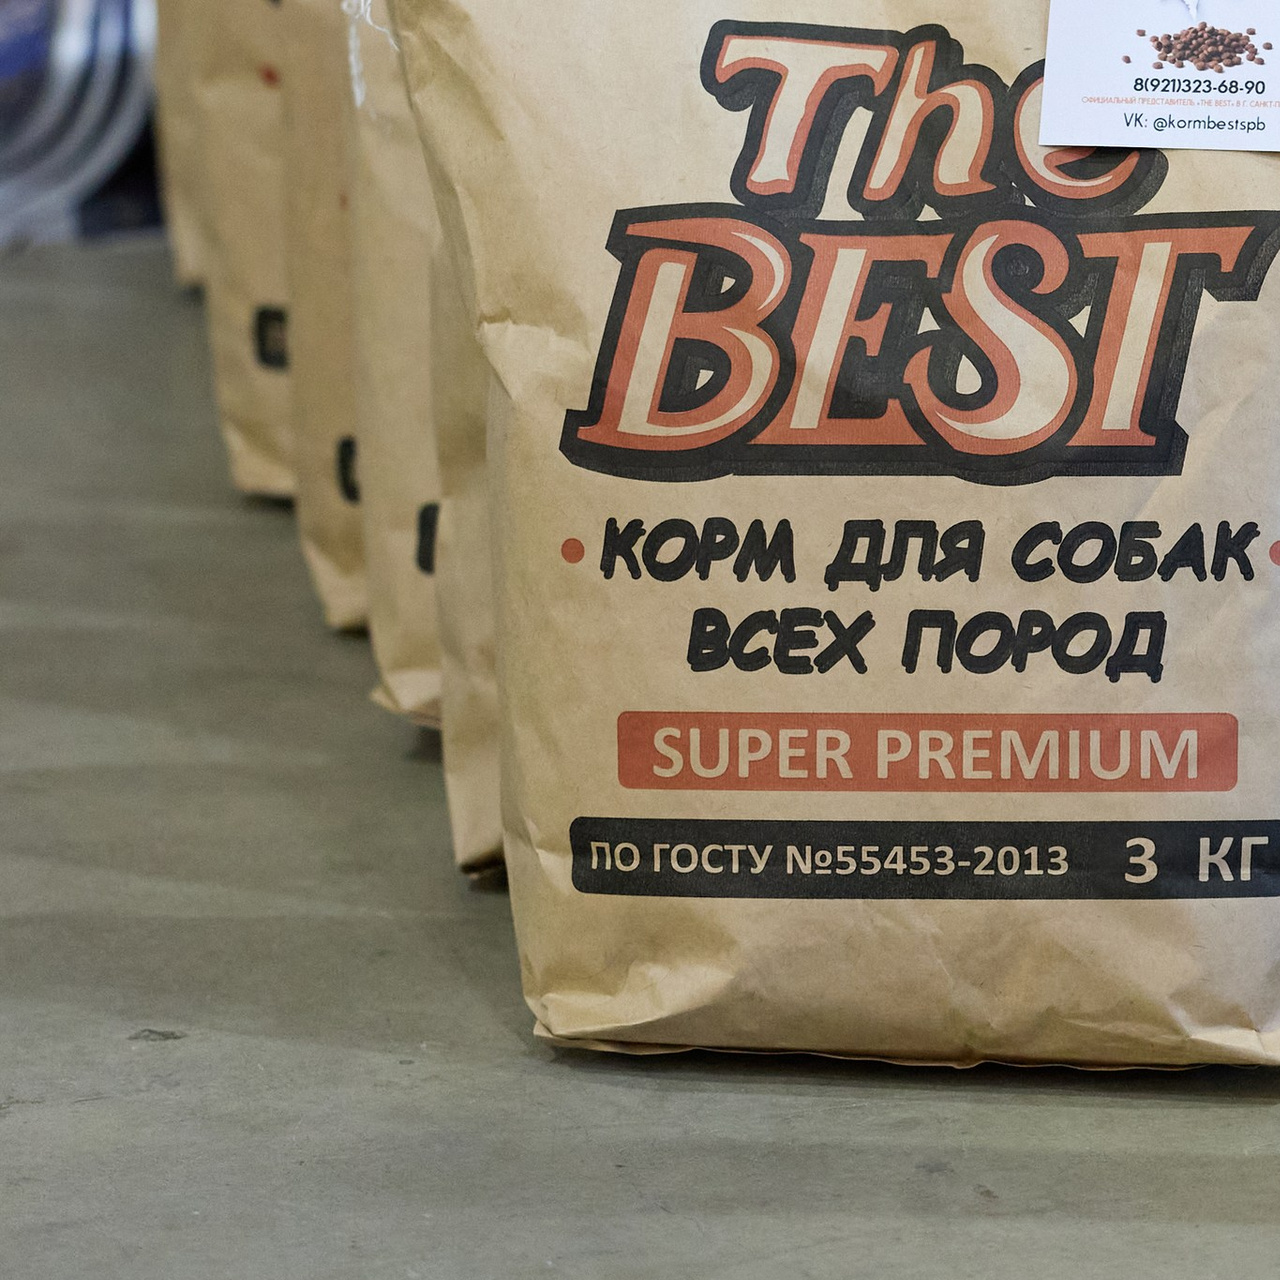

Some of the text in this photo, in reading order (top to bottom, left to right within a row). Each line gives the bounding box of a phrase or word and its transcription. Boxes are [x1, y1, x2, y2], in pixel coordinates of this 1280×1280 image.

[1133, 77, 1266, 95] 8(921)323-68-90
[1123, 112, 1267, 133] VK: @kormbestspb
[600, 517, 1261, 592] КОРМ ДЛЯ СОБАК
[686, 607, 1168, 683] ВСЕХ ПОРОД
[651, 725, 1200, 781] SUPER PREMIUM
[590, 835, 1270, 884] ПО ГОСТУ №55453-2013 3 КГ
